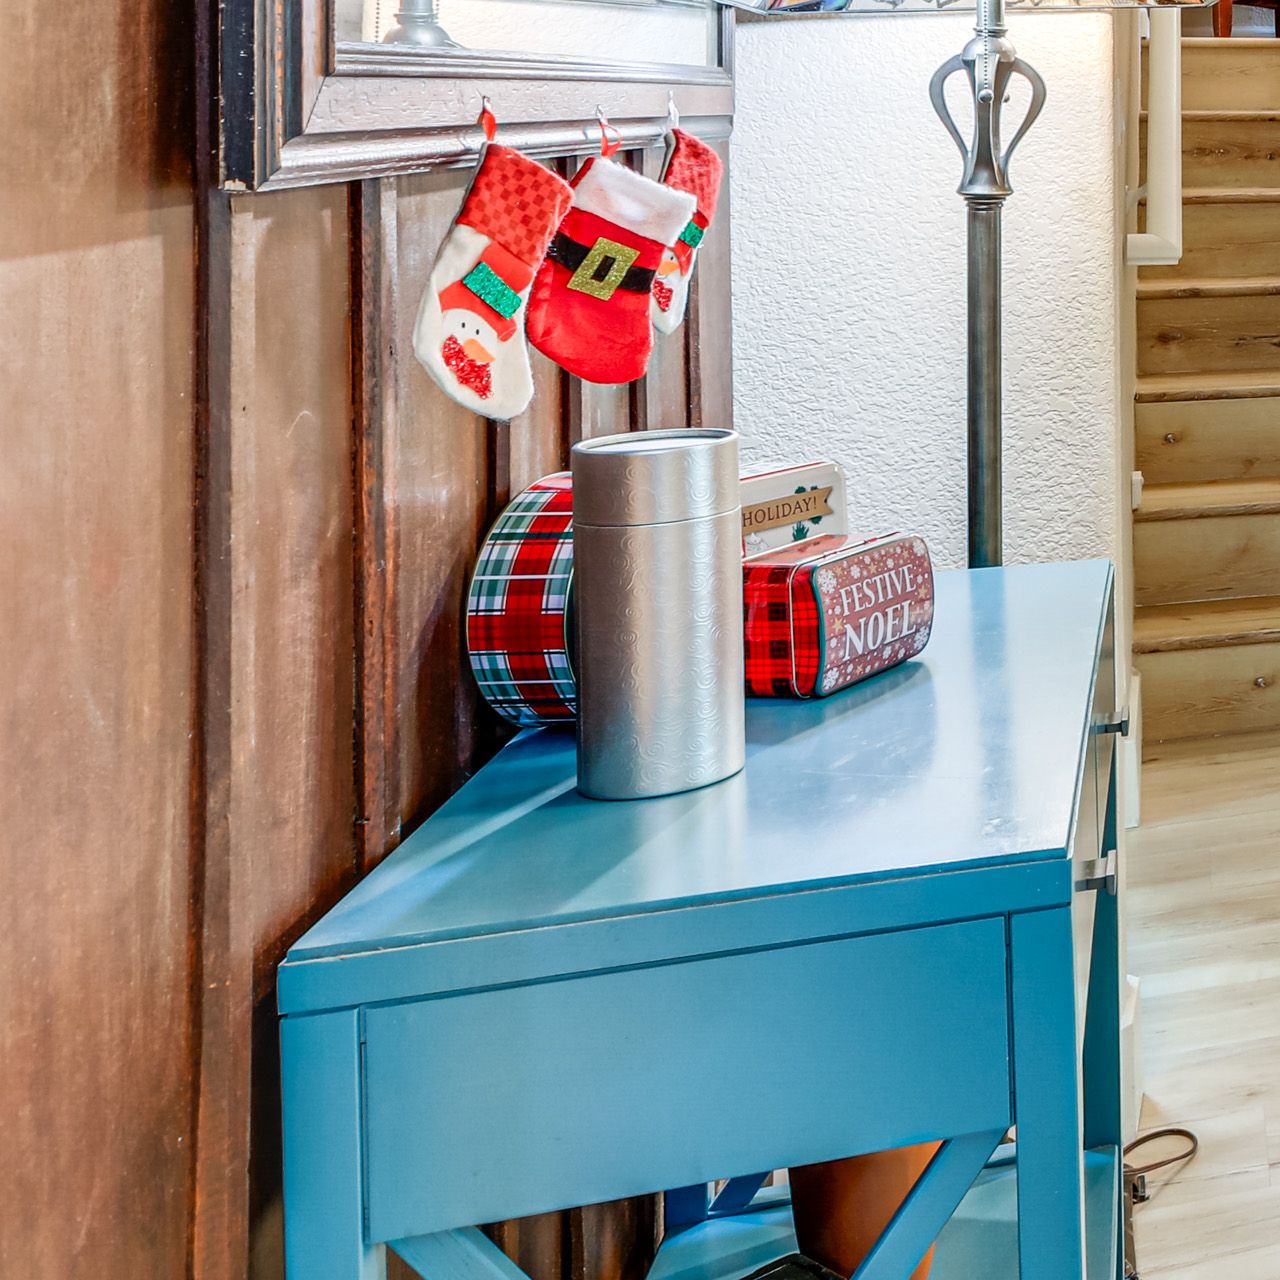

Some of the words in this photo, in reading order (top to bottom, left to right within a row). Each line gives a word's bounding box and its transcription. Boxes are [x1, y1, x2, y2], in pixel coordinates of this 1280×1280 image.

[743, 496, 817, 527] HOLIDAY!
[840, 563, 916, 617] FESTIVE
[842, 599, 916, 662] NOEL
